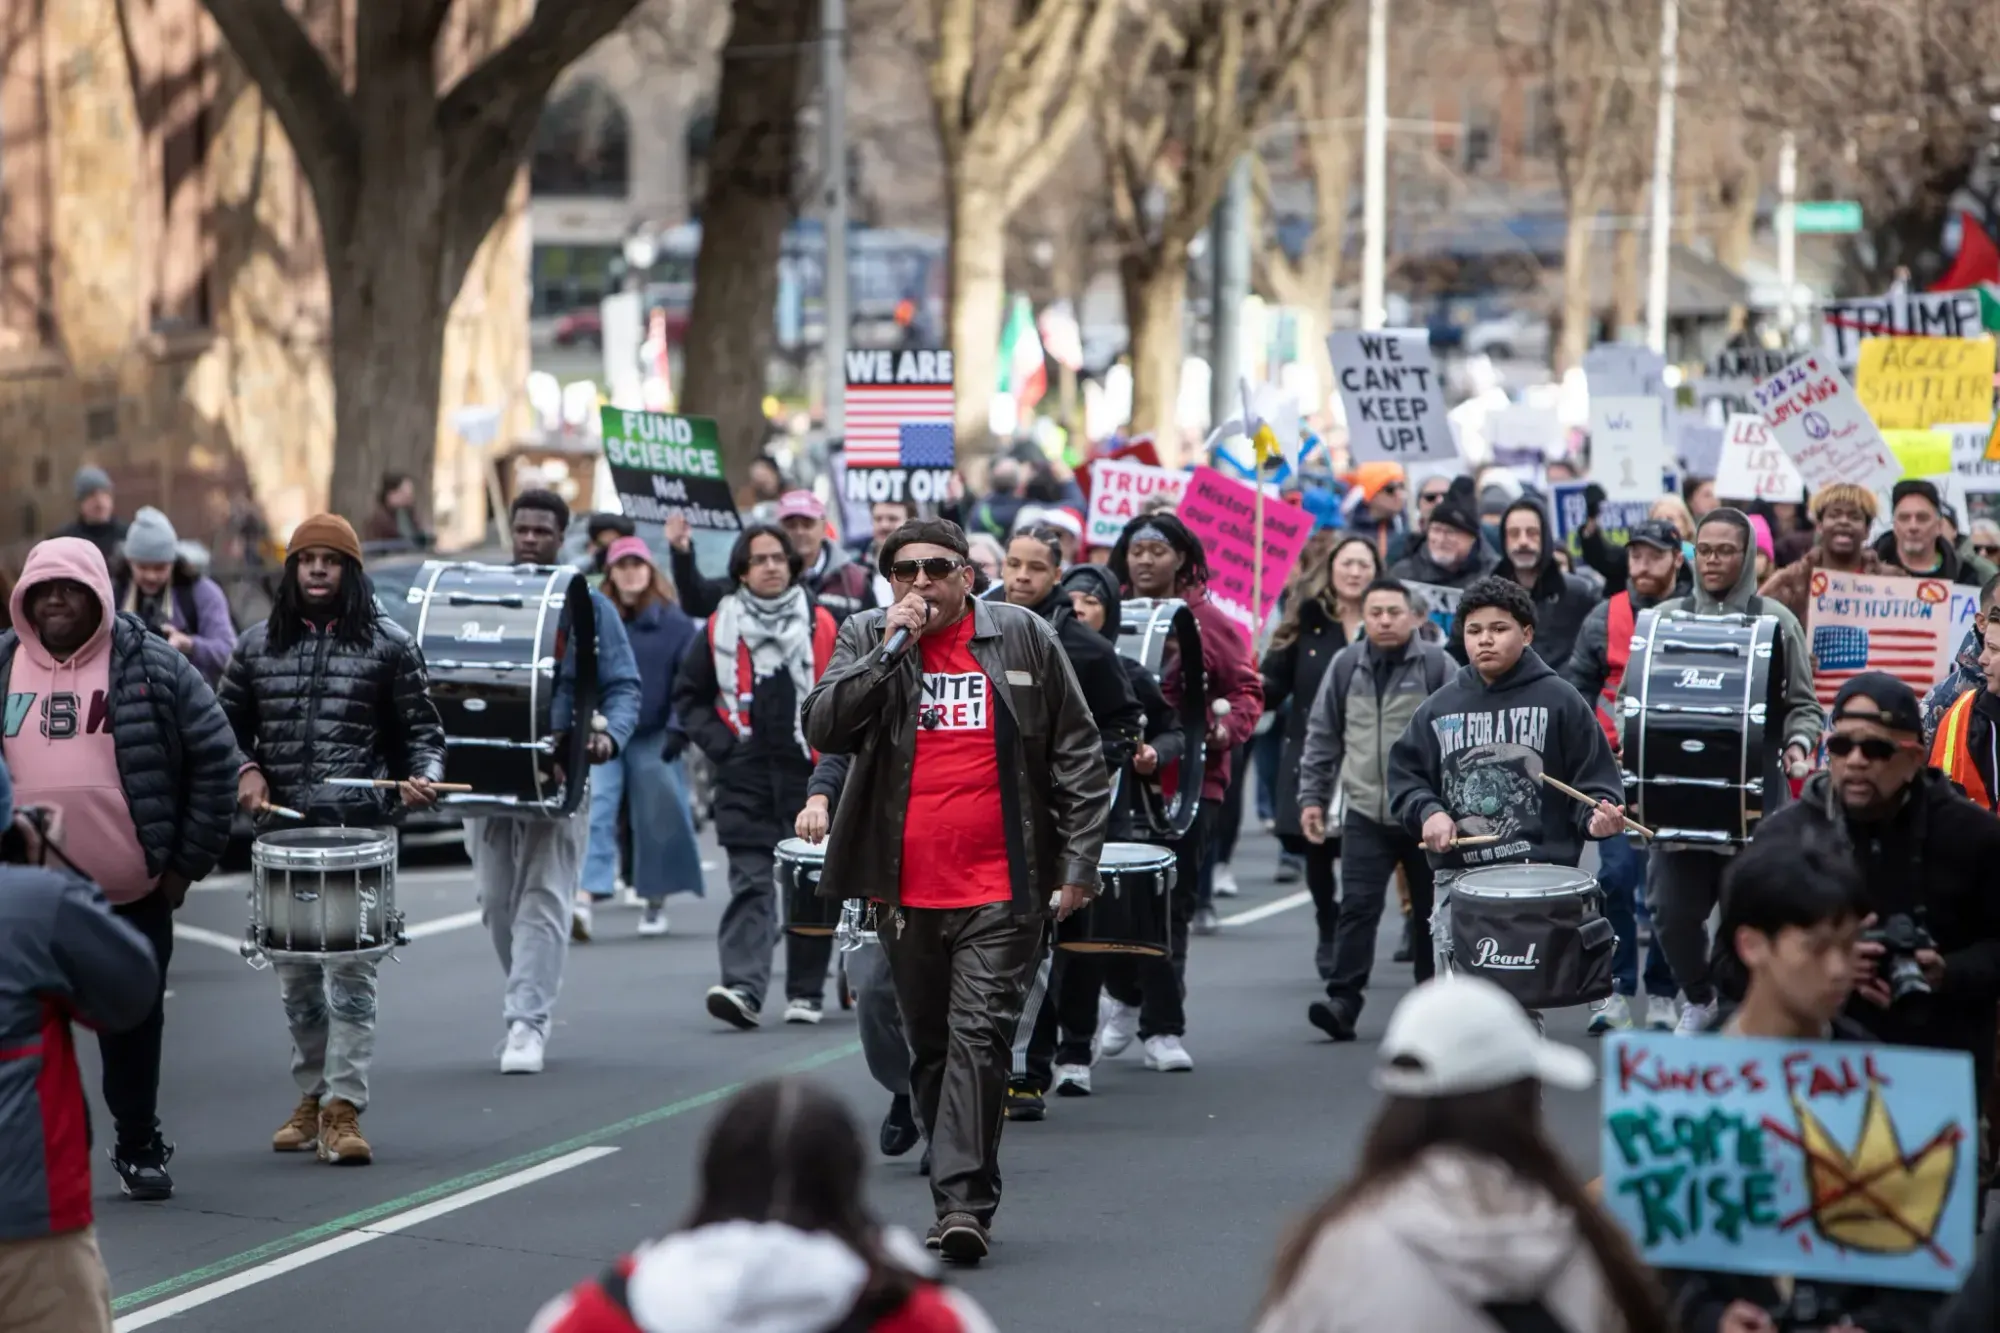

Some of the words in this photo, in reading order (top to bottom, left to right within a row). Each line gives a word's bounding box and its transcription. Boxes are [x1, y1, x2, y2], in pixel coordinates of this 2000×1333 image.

[1823, 298, 1978, 355] TRUMP
[1358, 337, 1402, 361] WE
[847, 350, 894, 382] WE
[896, 350, 953, 382] ARE
[1341, 367, 1431, 392] CAN'T
[1358, 397, 1429, 422] KEEP
[621, 412, 693, 445] FUND
[1376, 427, 1429, 452] UP!
[606, 437, 720, 476] SCIENCE
[651, 474, 688, 500] Not
[847, 469, 907, 501] NOT
[909, 469, 952, 501] OK
[619, 491, 739, 529] Billionaires
[1197, 481, 1256, 525] History
[1264, 515, 1300, 539] and
[1816, 594, 1934, 621] CONSTITUTION
[454, 621, 506, 643] Pearl
[921, 675, 984, 701] NITE
[1674, 668, 1725, 689] Pearl
[918, 701, 981, 727] ERE!
[1466, 711, 1493, 748] FOR
[1495, 709, 1507, 744] A
[1509, 706, 1549, 753] YEAR
[359, 886, 378, 943] Pearl
[1471, 936, 1538, 968] Pearl
[1617, 1165, 1780, 1248] RISE
